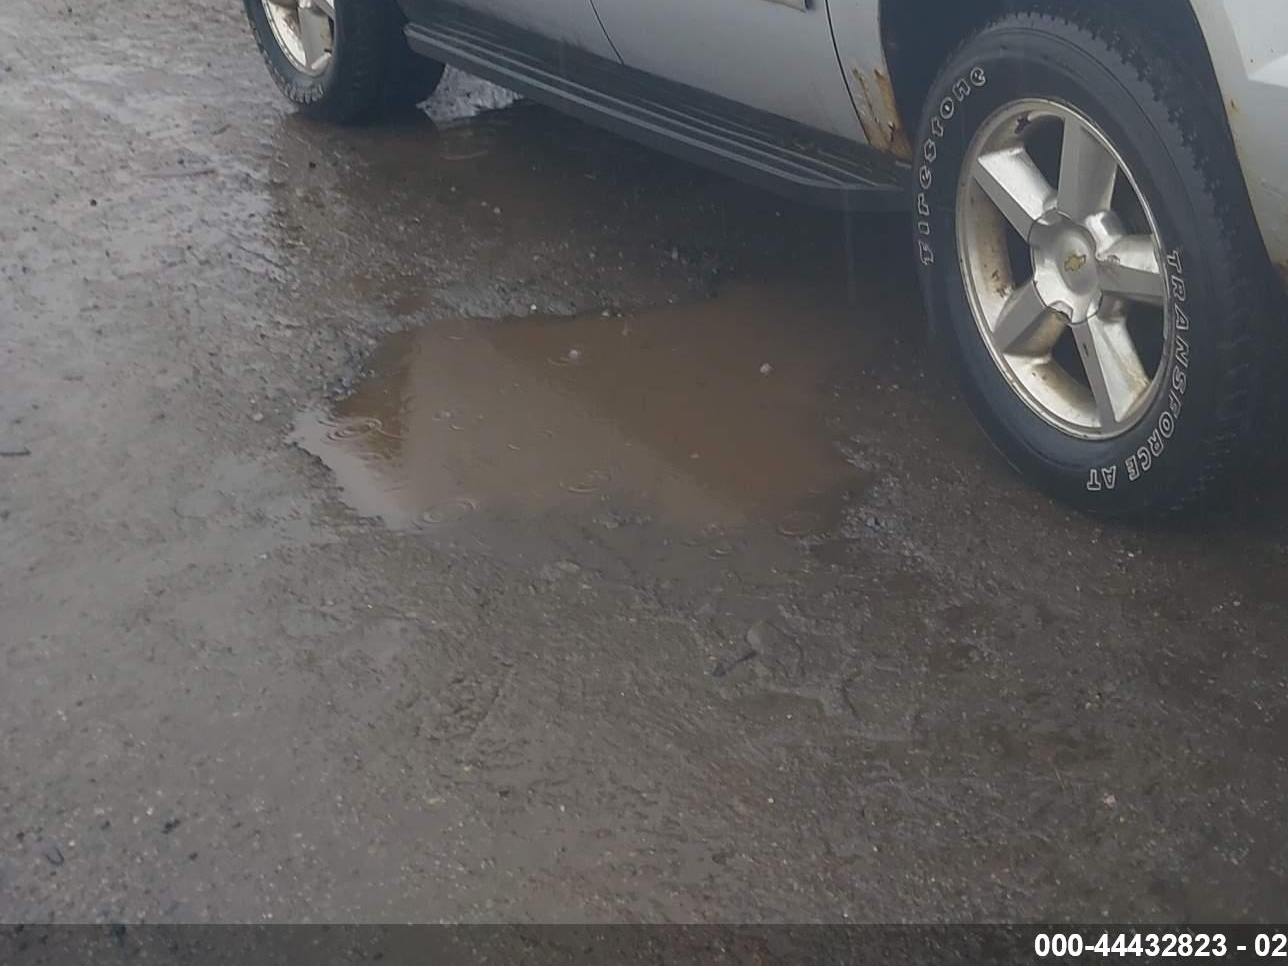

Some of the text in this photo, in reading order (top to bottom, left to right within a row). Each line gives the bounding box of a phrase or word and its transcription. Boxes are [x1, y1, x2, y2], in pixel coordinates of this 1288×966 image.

[917, 66, 986, 266] Firestone
[1086, 249, 1191, 491] TRANSFORCE AT
